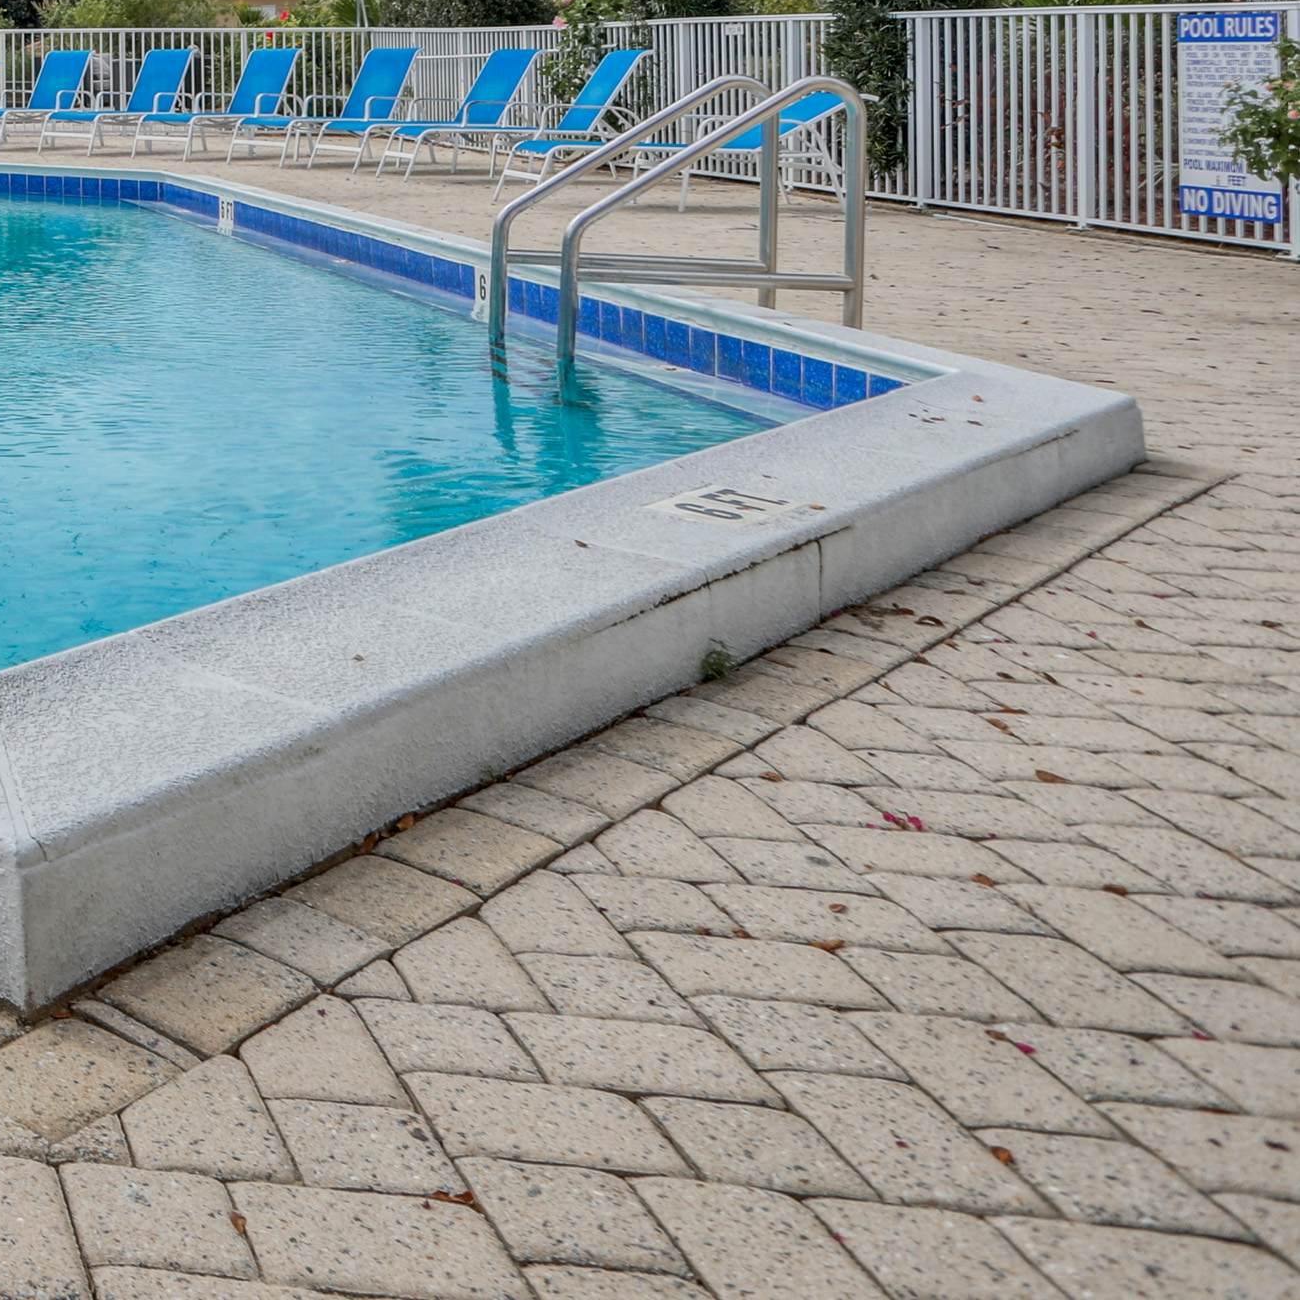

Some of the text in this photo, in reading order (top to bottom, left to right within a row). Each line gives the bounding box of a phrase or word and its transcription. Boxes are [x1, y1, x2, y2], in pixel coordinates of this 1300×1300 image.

[1180, 16, 1275, 38] POOL RULES
[1183, 158, 1203, 170] POOL
[1183, 188, 1278, 220] NO DIVING
[479, 274, 486, 301] 6
[674, 503, 744, 520] 6
